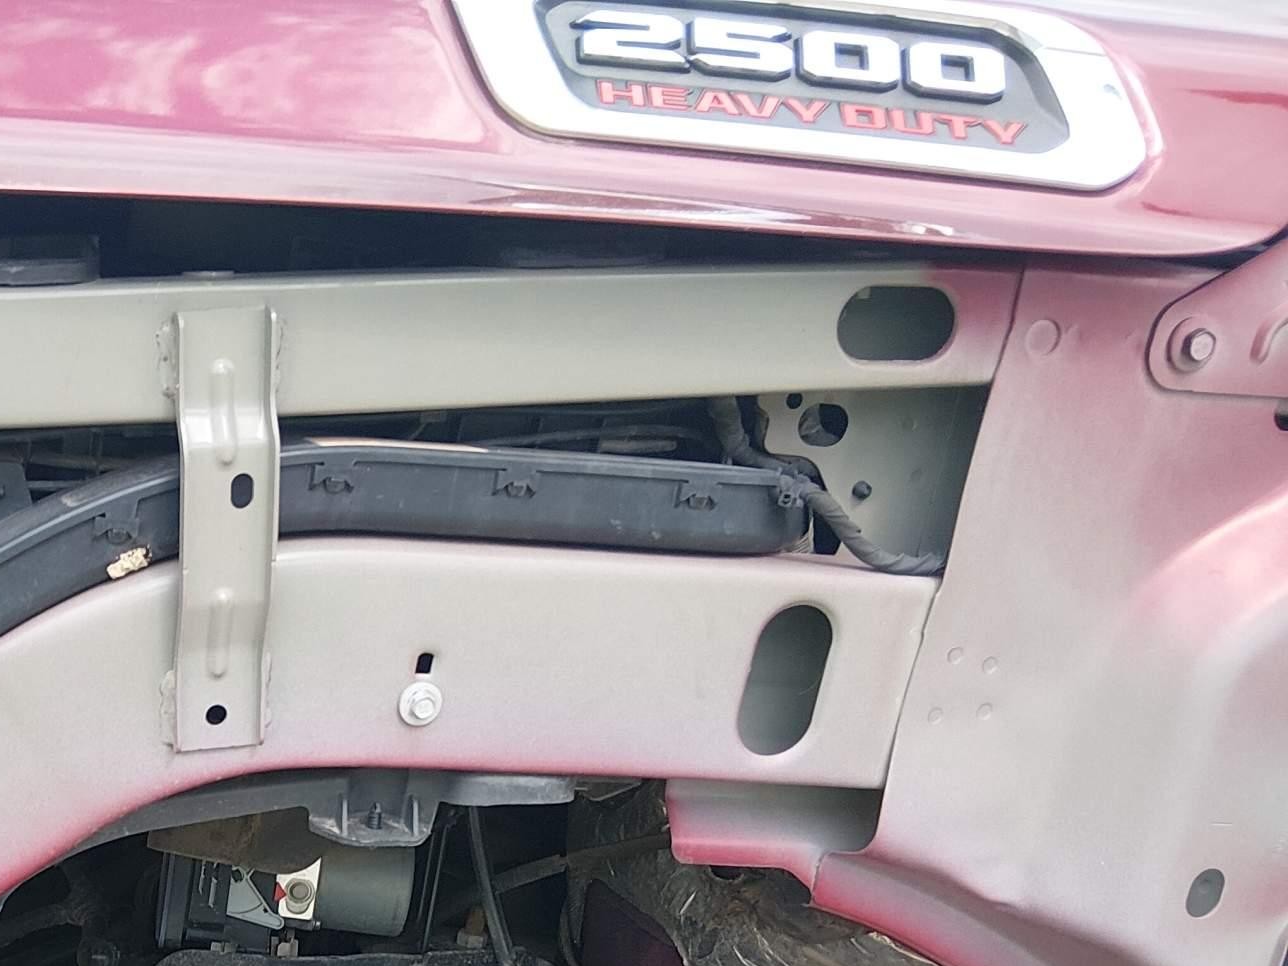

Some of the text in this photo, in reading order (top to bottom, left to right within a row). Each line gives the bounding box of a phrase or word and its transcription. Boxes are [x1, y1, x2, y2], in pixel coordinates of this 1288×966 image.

[571, 10, 1005, 102] 2500
[596, 80, 1027, 146] HEAVY DUTY
